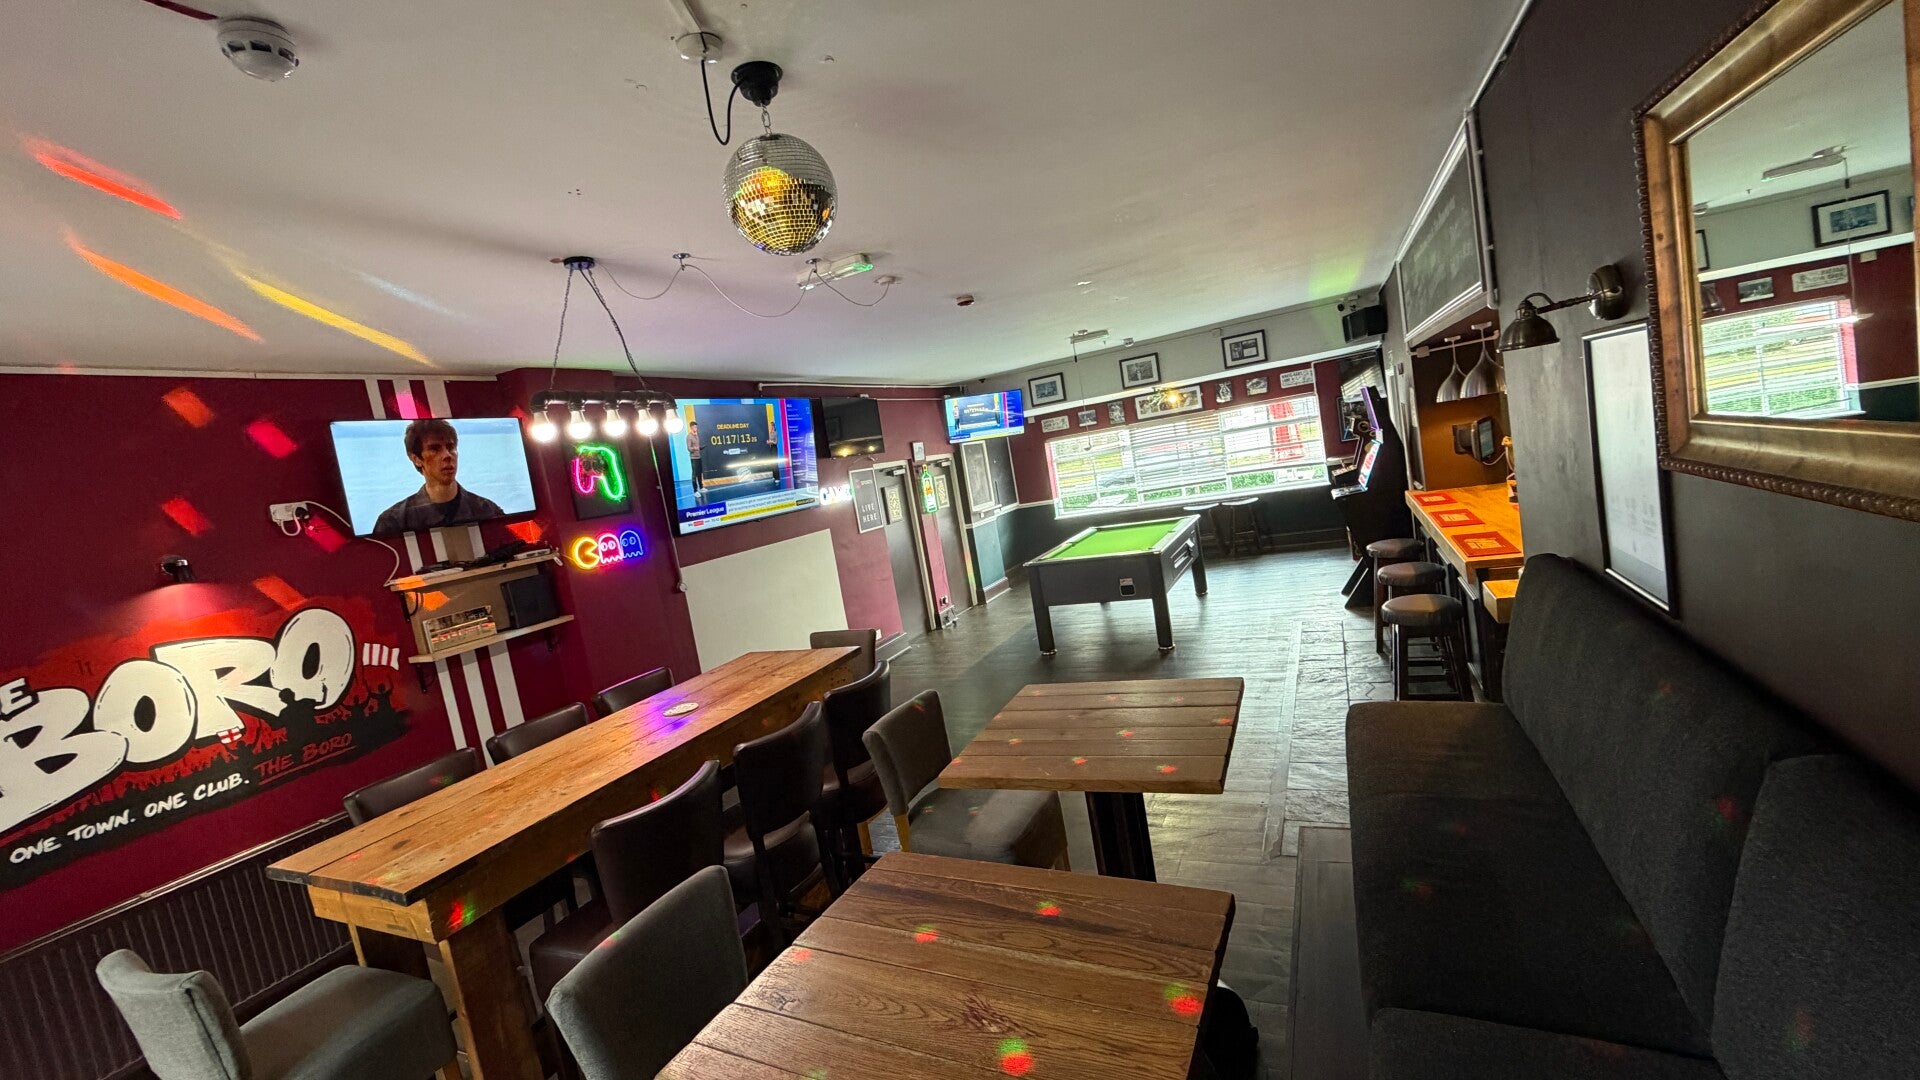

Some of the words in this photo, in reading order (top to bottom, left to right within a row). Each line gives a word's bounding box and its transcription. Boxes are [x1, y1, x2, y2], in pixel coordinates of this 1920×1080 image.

[686, 508, 707, 519] Premier
[707, 505, 725, 516] League
[861, 502, 875, 513] LIVE
[862, 512, 878, 523] HERE
[0, 607, 355, 833] BORO
[9, 836, 62, 864] ONE
[66, 808, 137, 842] TOWN.
[143, 791, 188, 818] ONE
[192, 771, 251, 801] CLUB.
[252, 754, 295, 776] THE
[302, 732, 353, 763] BORO
